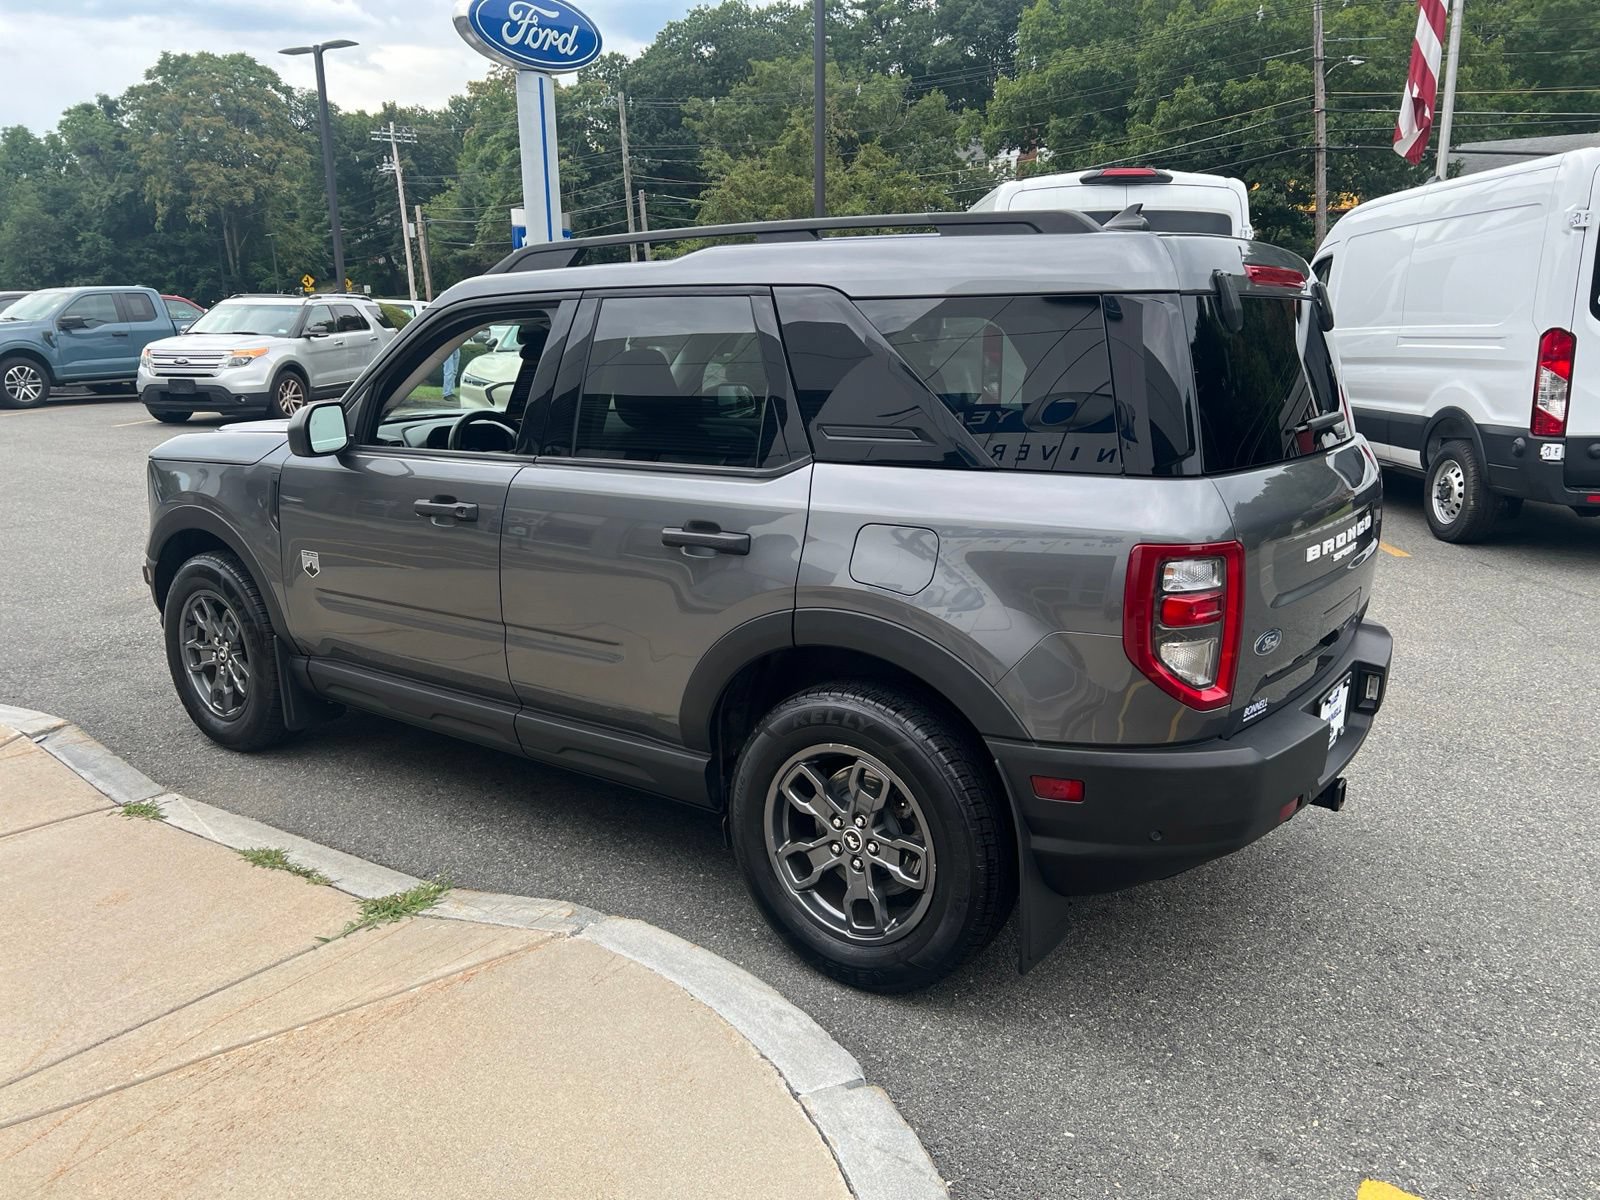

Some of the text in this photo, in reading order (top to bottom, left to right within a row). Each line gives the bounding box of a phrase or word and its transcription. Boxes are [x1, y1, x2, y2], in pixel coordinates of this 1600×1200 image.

[501, 1, 579, 56] Ford
[1305, 514, 1372, 563] BRONCO
[1332, 541, 1358, 562] SPORT
[1242, 697, 1268, 718] BONNELL
[791, 708, 874, 733] KELLY
